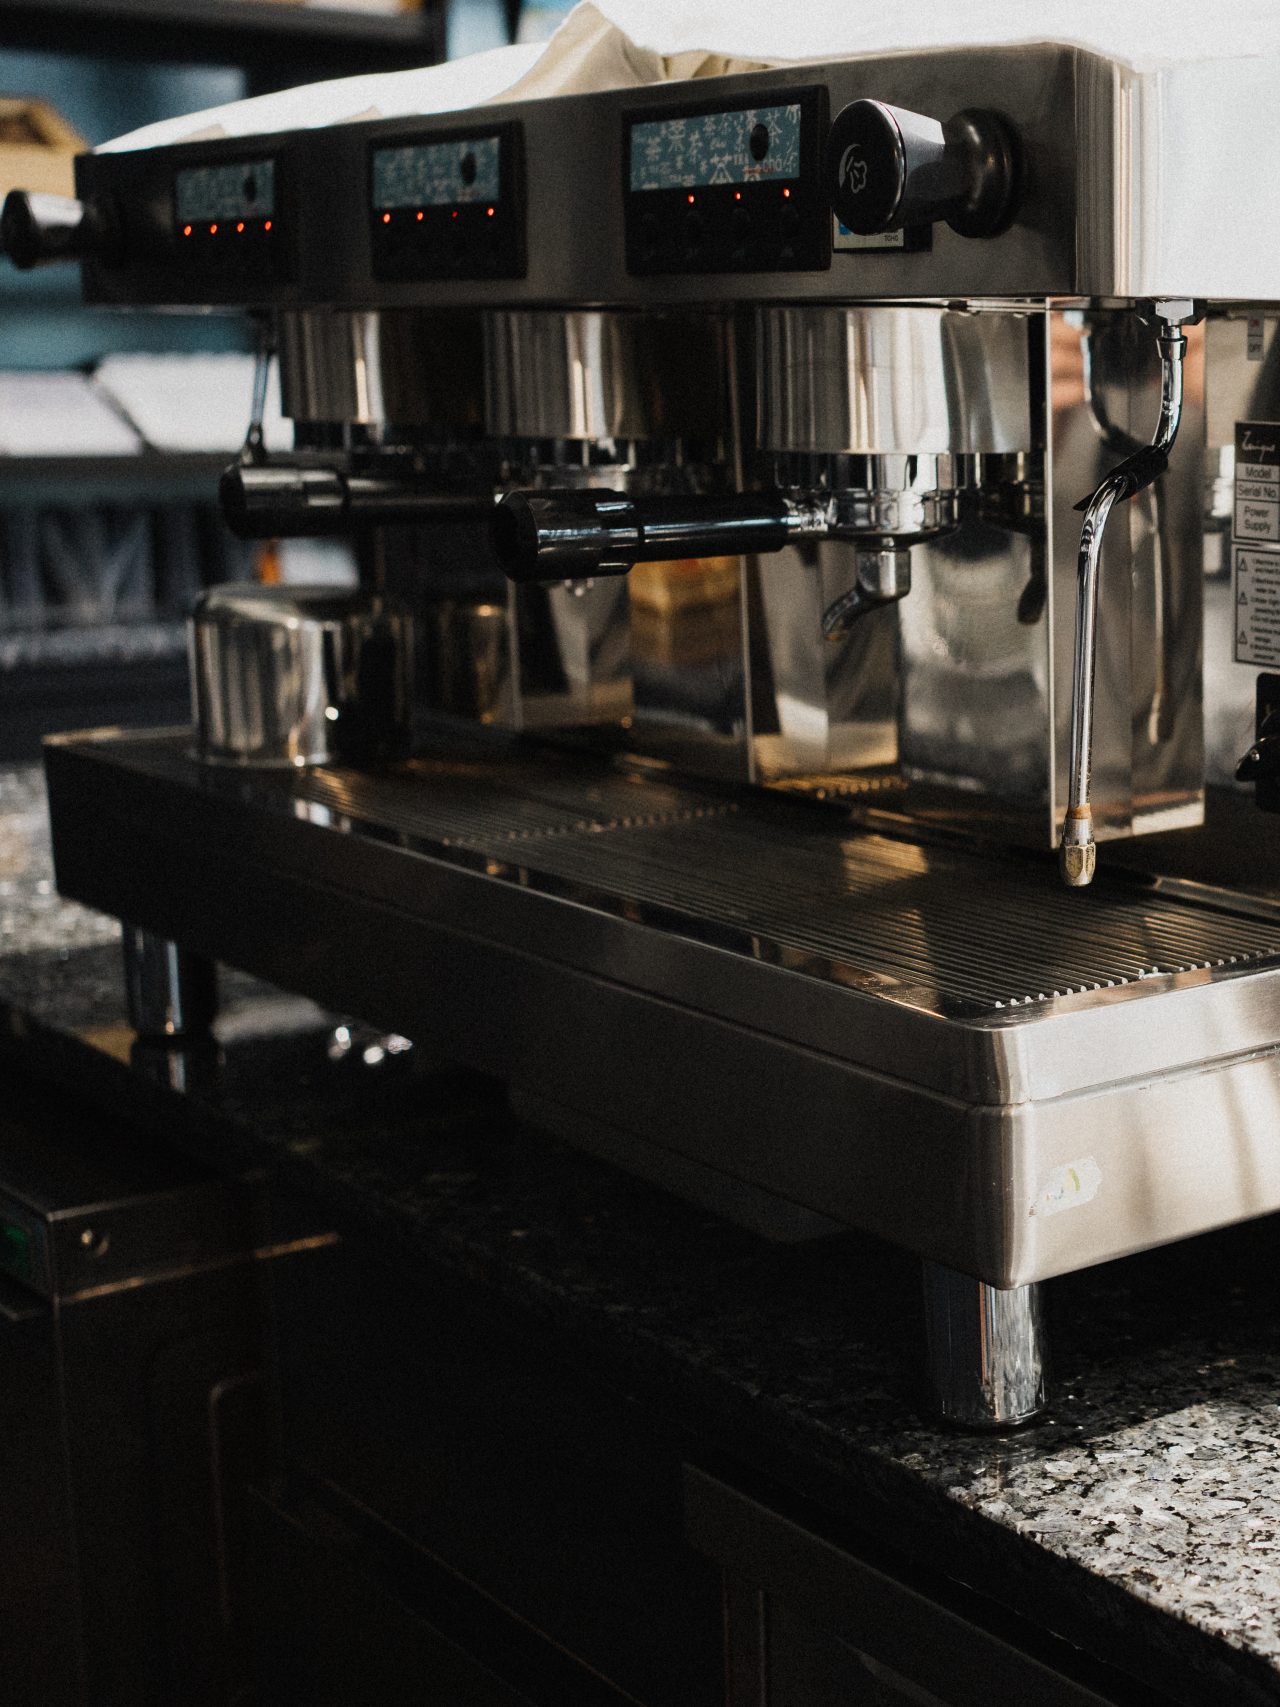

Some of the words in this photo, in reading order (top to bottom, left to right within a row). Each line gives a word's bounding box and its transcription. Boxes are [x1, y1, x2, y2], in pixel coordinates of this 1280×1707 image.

[1245, 466, 1271, 479] Model
[1238, 484, 1262, 498] Serial
[1244, 505, 1269, 518] Power
[1244, 519, 1271, 534] Supply
